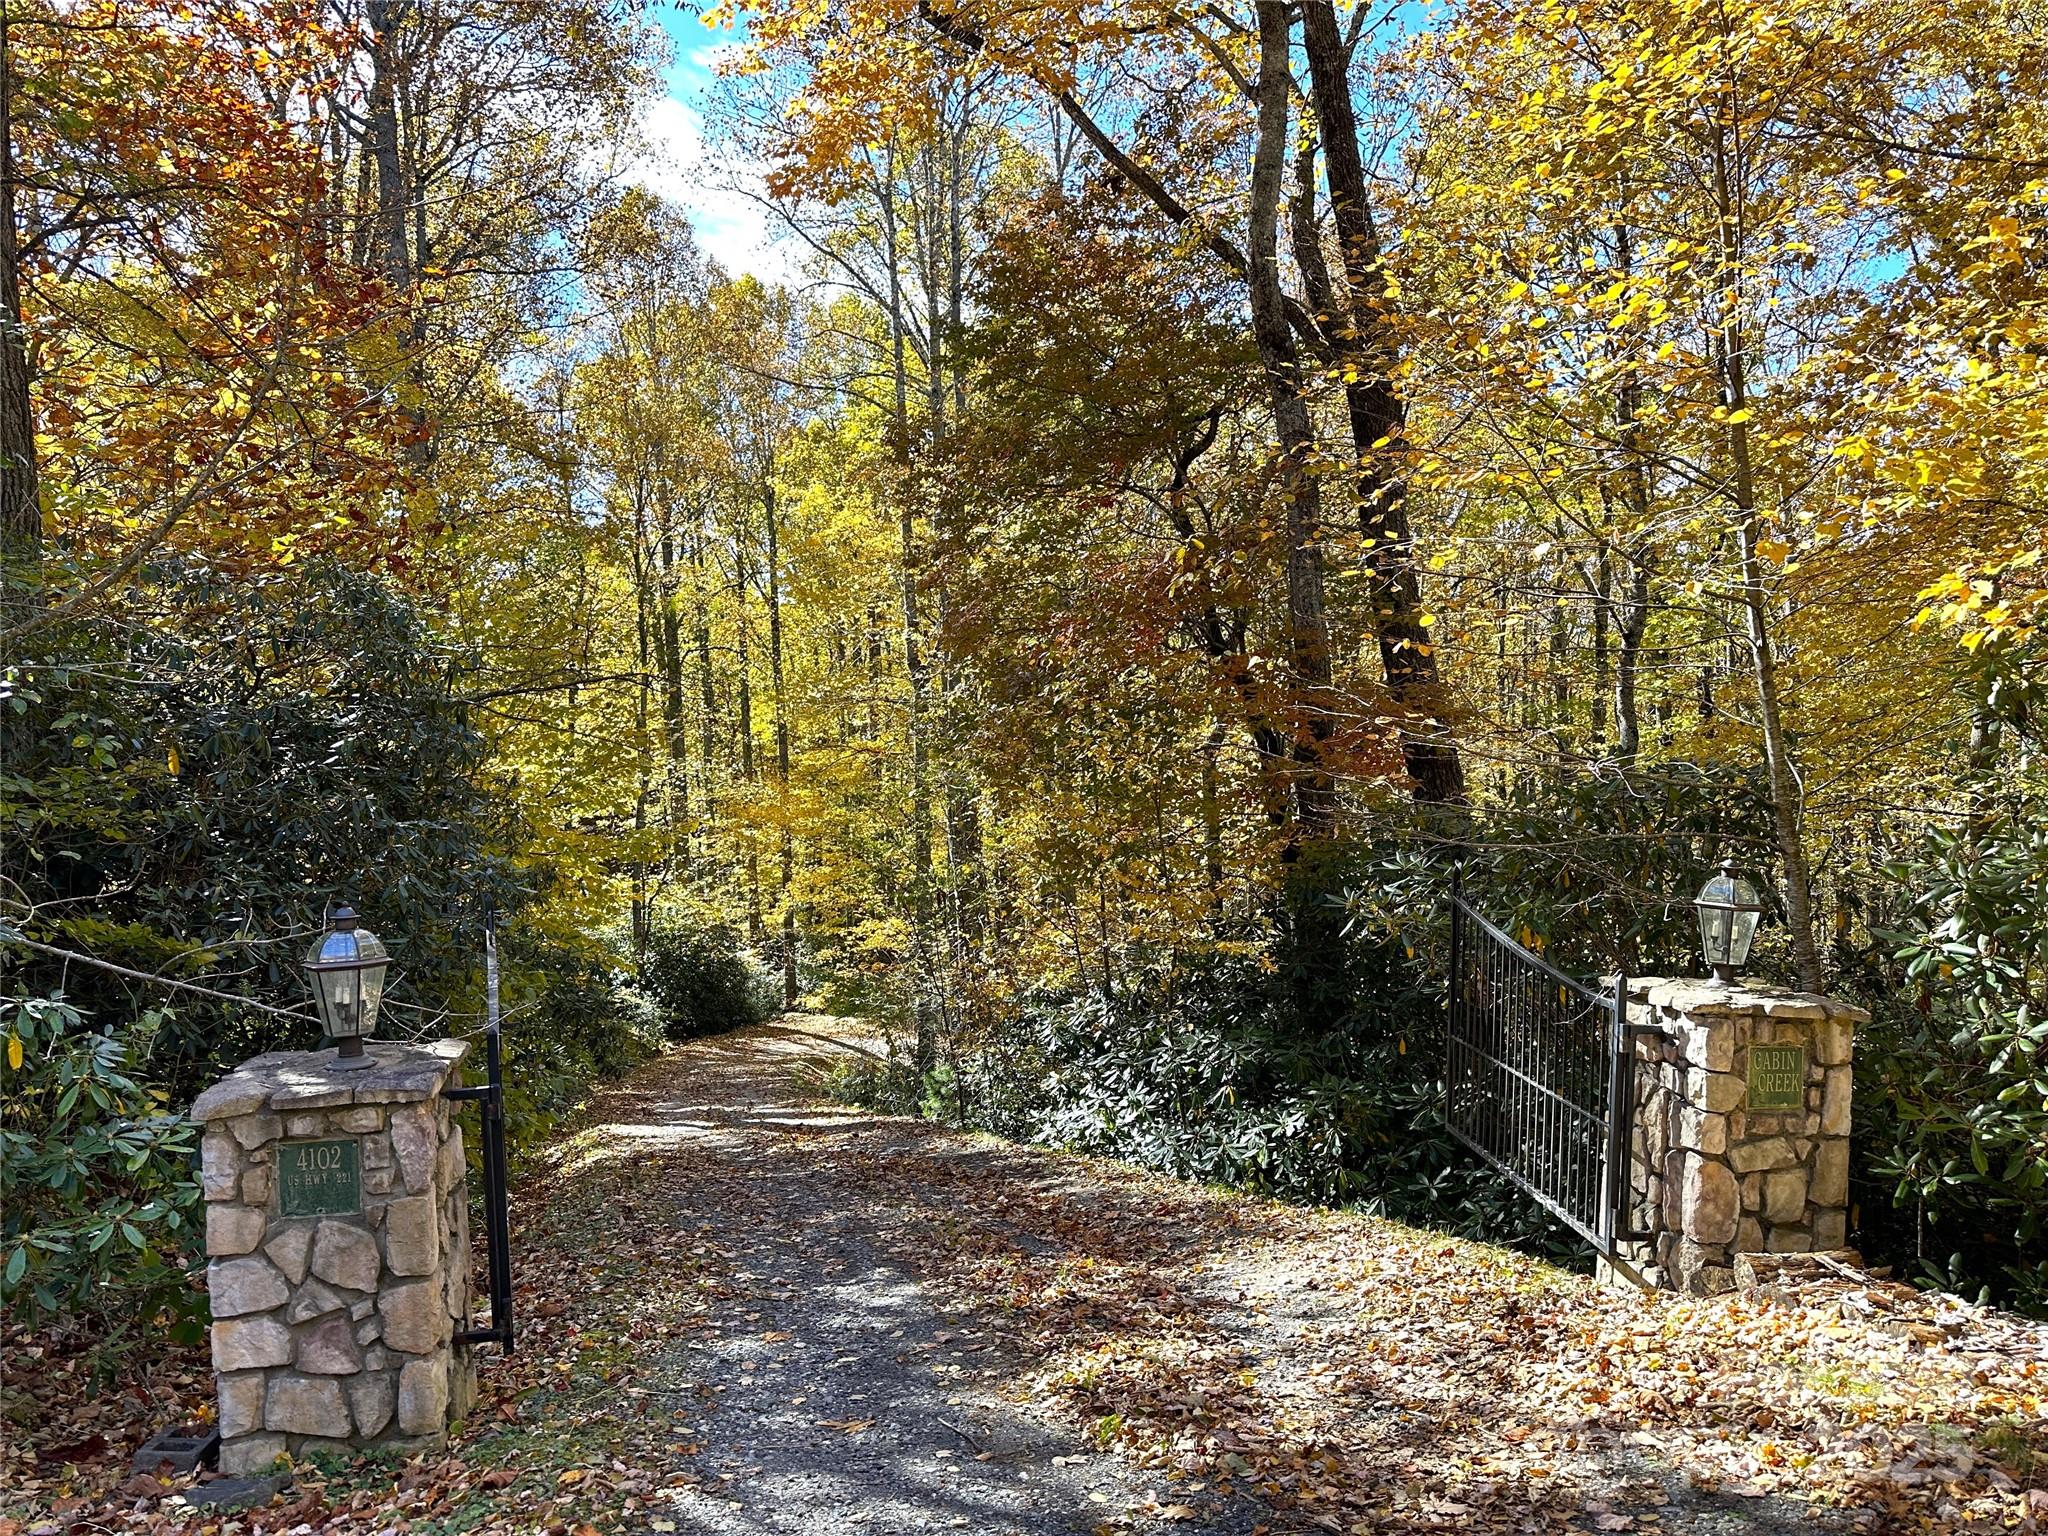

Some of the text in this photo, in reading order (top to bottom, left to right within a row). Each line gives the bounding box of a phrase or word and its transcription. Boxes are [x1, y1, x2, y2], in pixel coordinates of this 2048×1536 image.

[1753, 1051, 1796, 1070] CABIN
[1758, 1073, 1801, 1092] CREEK
[296, 1145, 341, 1171] 4102
[287, 1171, 352, 1186] US HWY 221
